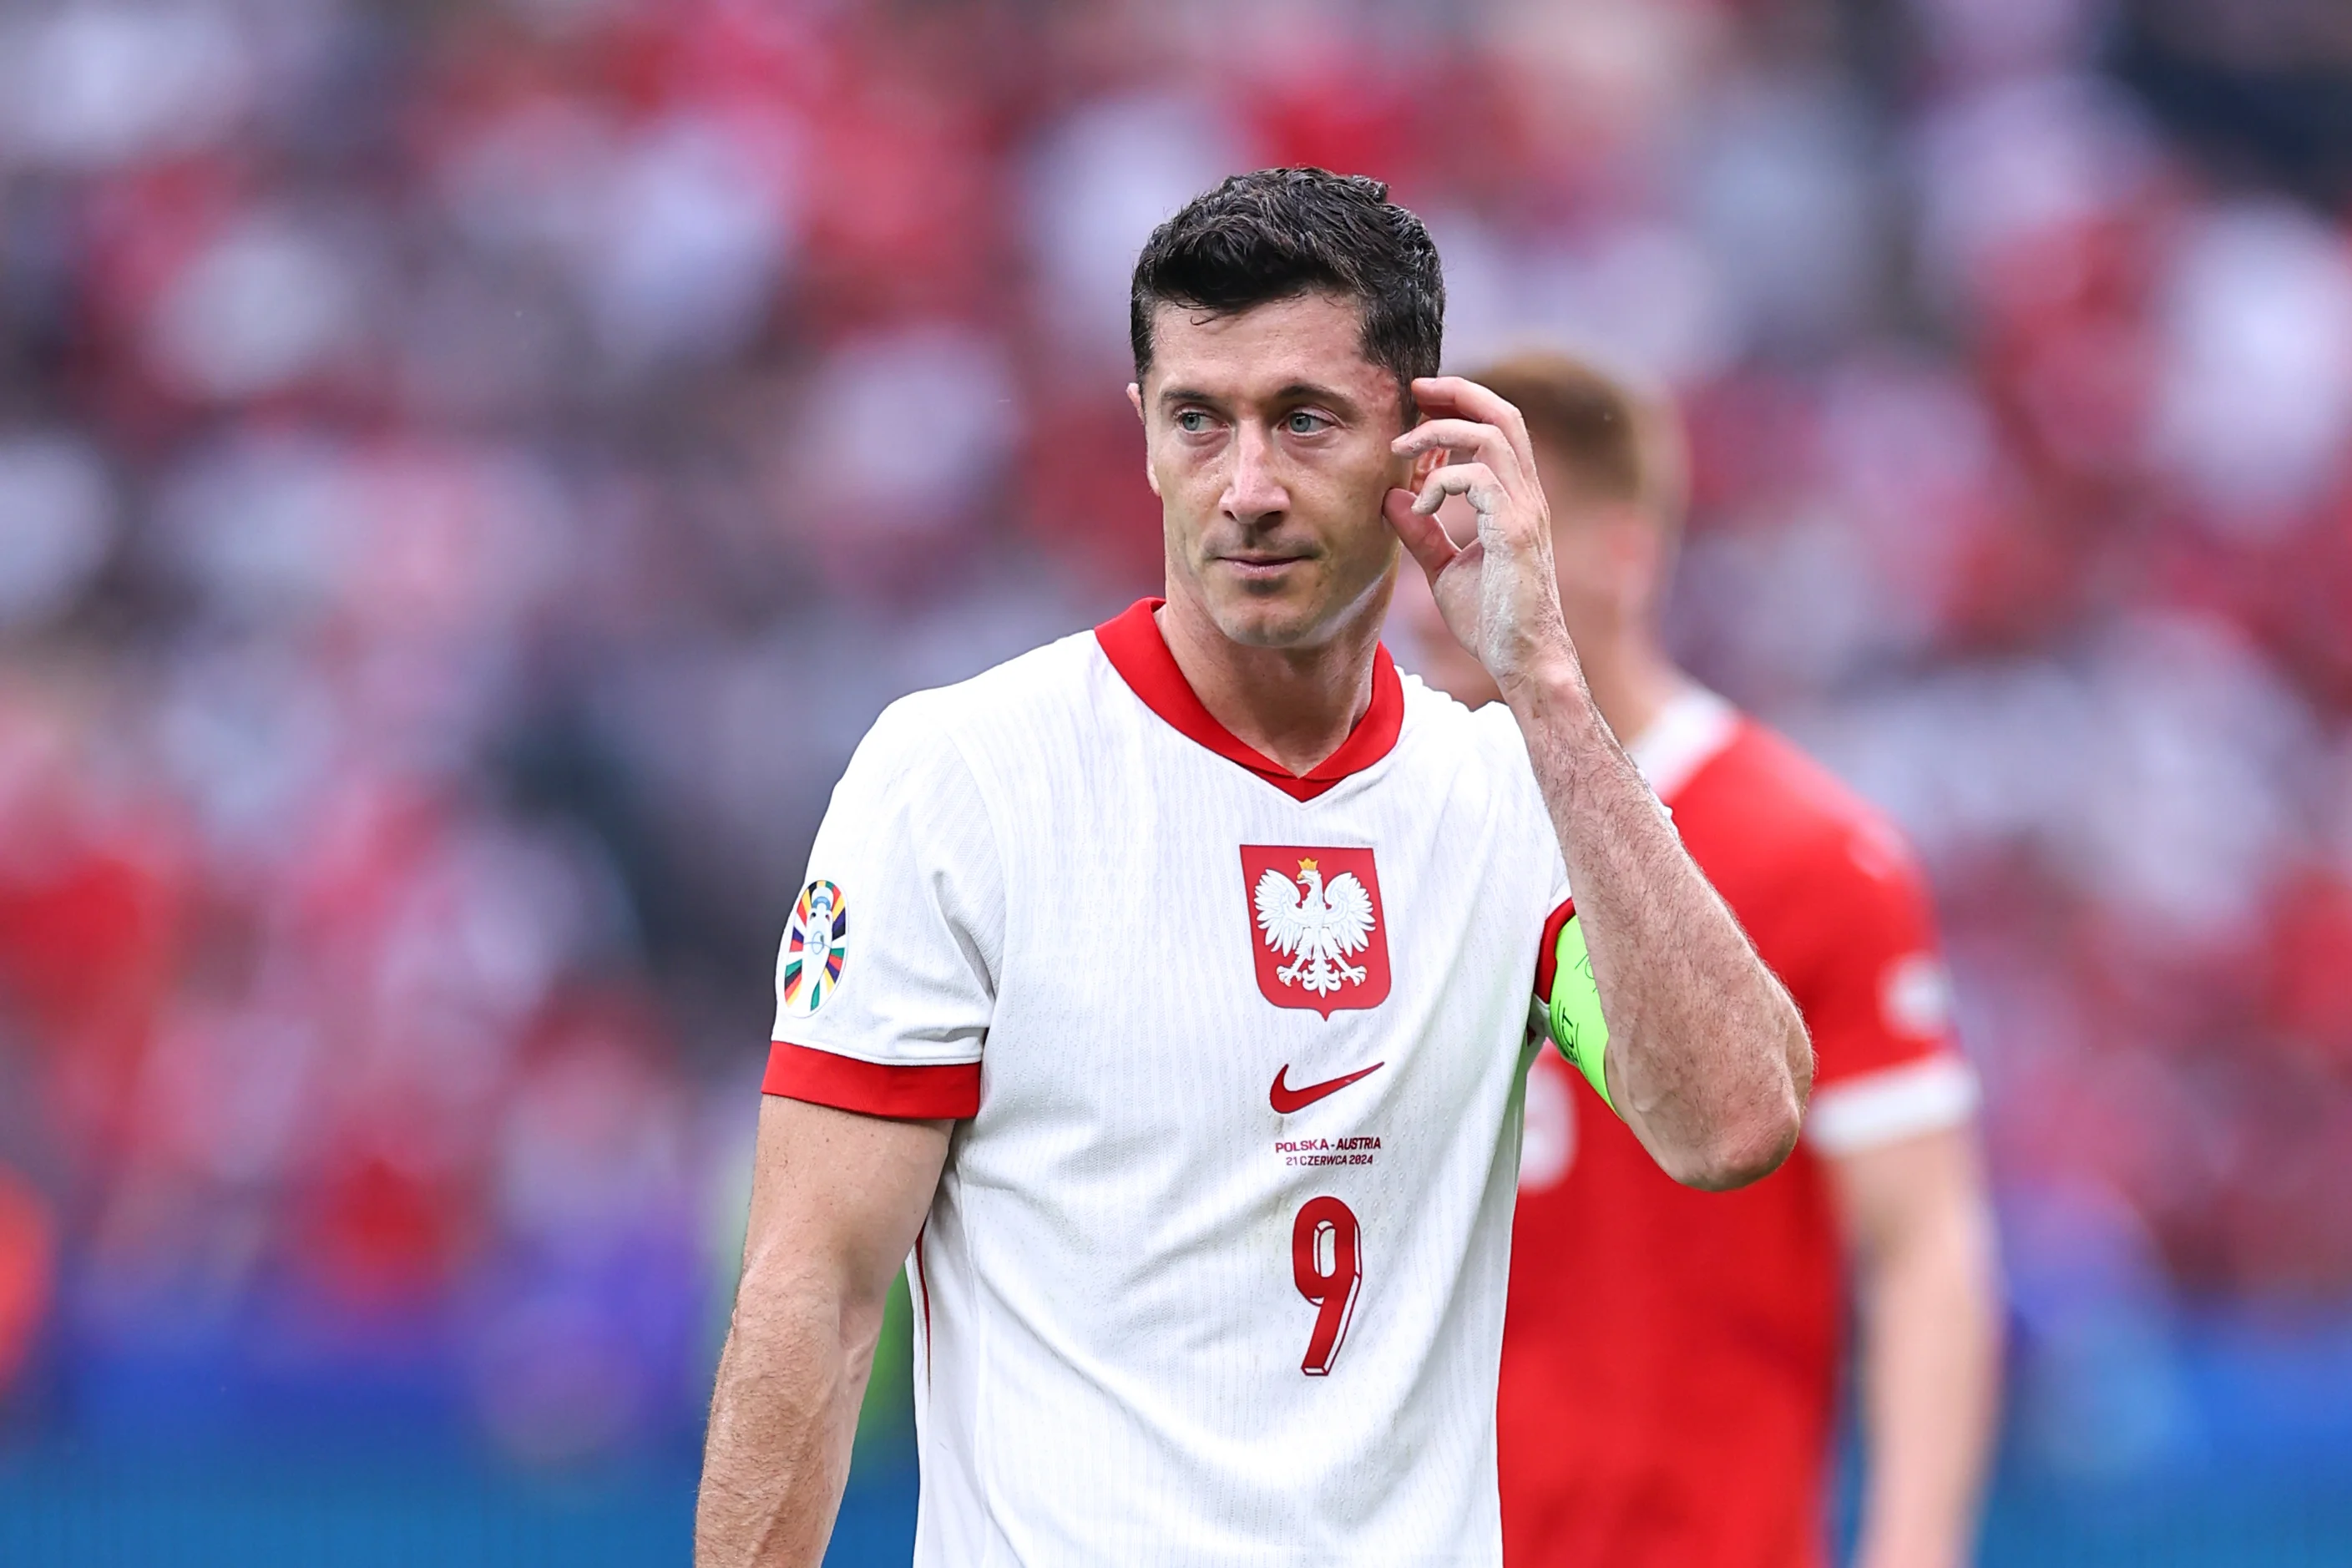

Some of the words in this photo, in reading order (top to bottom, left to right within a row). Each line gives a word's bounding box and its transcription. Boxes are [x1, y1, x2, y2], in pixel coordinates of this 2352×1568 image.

[1275, 1138, 1329, 1153] POLSKA
[1336, 1136, 1381, 1151] AUSTRIA
[1286, 1156, 1297, 1166] 21
[1300, 1155, 1347, 1166] CZERWCA
[1348, 1154, 1373, 1165] 2024
[1292, 1196, 1363, 1377] 9
